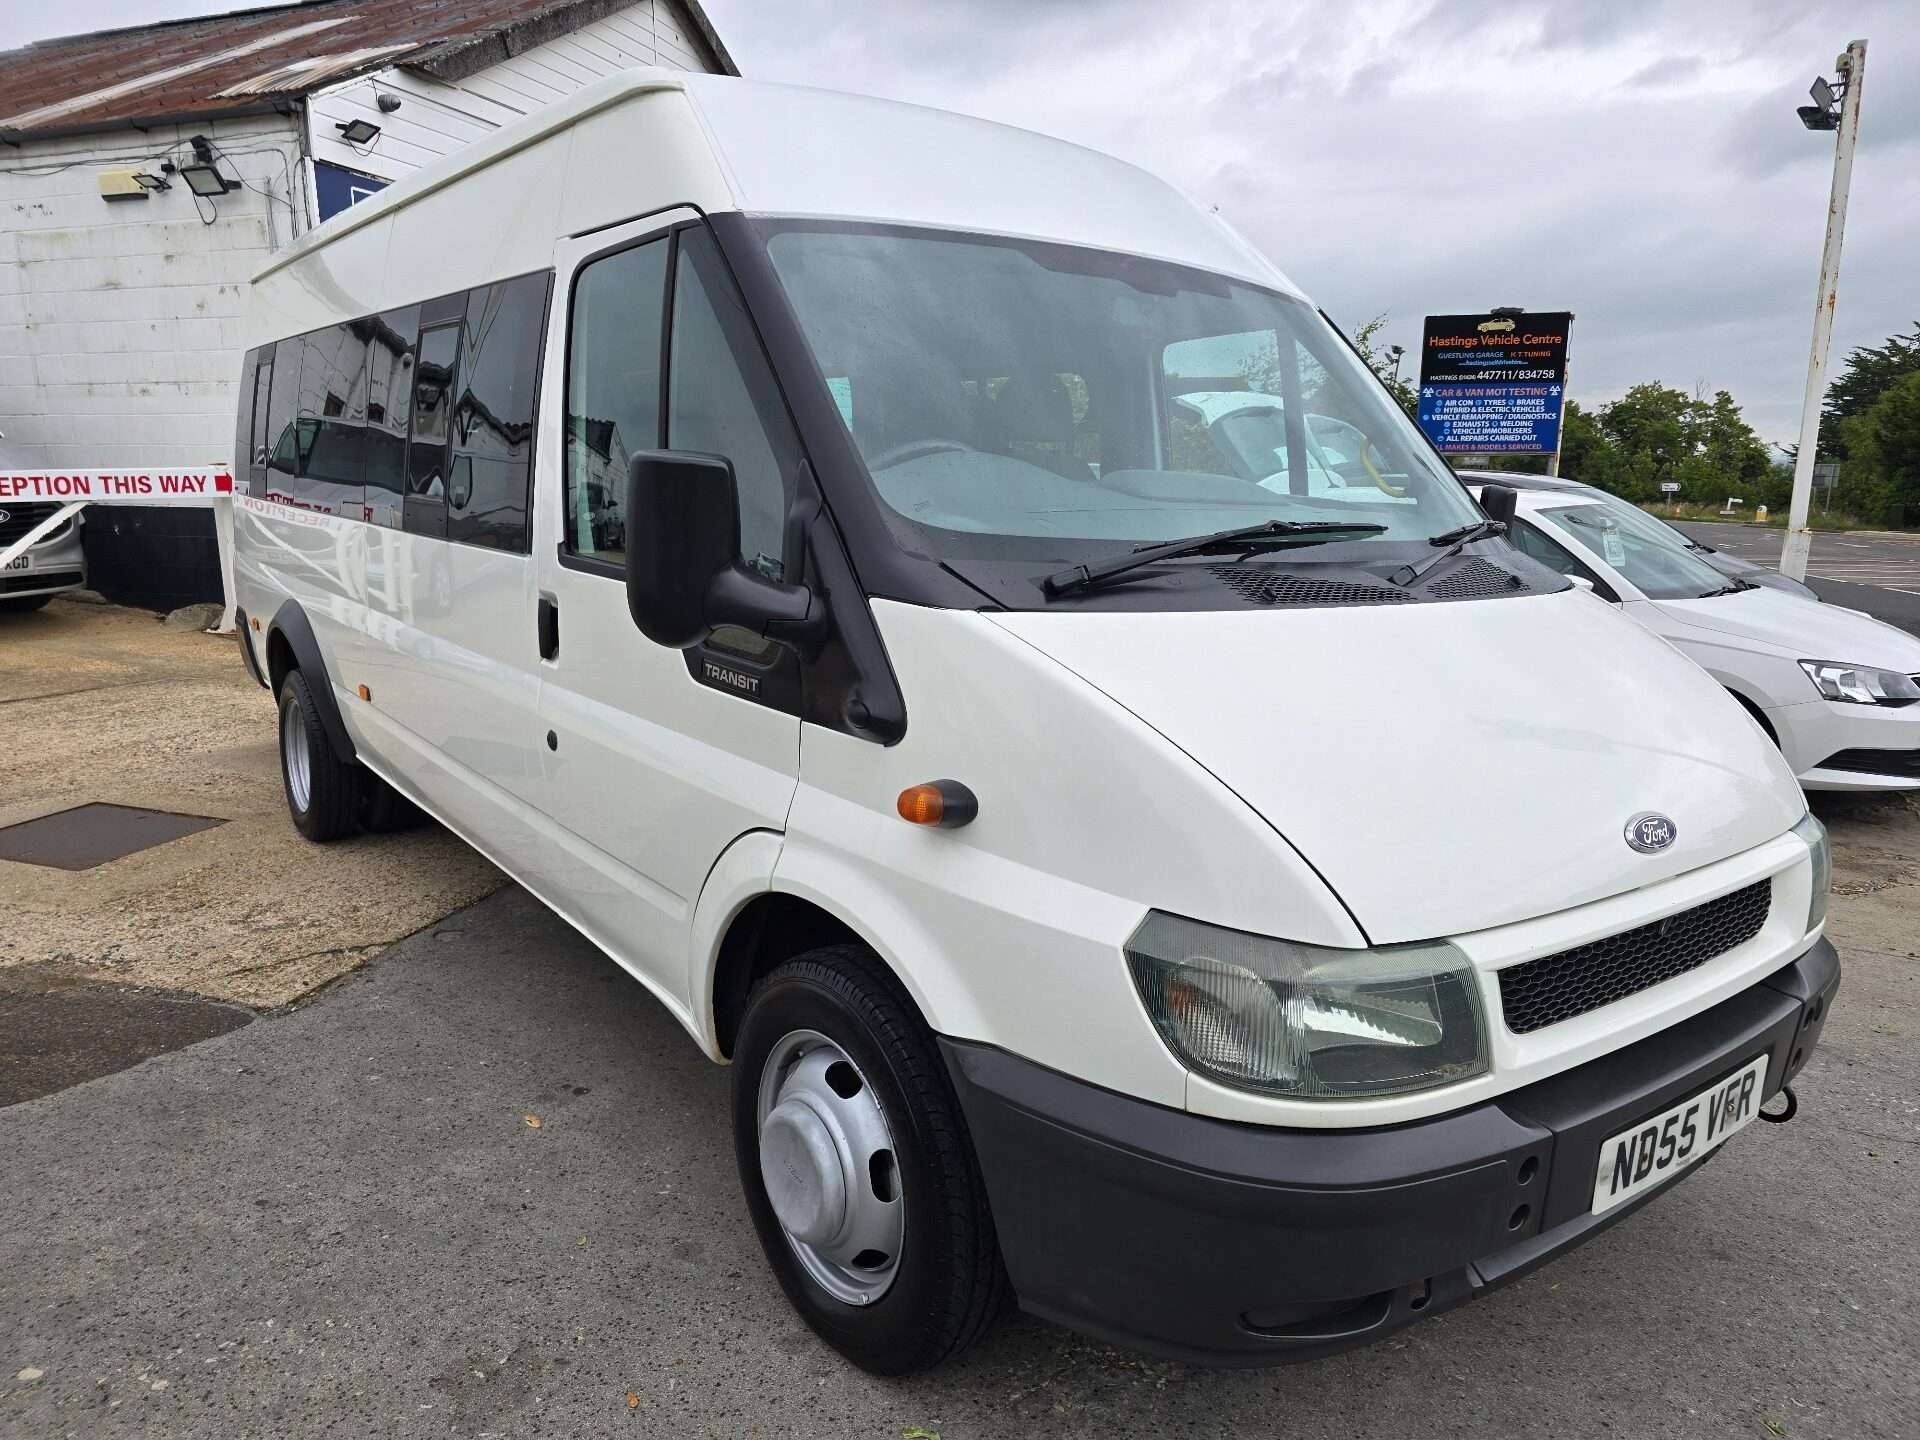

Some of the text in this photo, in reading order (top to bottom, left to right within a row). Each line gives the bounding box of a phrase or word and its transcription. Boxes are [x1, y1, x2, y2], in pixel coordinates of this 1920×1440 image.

[1429, 333, 1562, 348] Hastings Vehicle Centre
[1475, 351, 1504, 359] GARAGE
[1477, 369, 1555, 380] 447711/834758
[1435, 387, 1548, 398] CAR & VAN MOT TESTING
[1444, 399, 1457, 407] AIR
[1516, 398, 1545, 406] BRAKES
[1511, 405, 1545, 413] VEHICLES
[1508, 412, 1557, 420] DIAGNOSTICS
[1452, 420, 1490, 428] EXHAUSTS
[1460, 434, 1489, 442] REPAIRS
[98, 475, 151, 495] THIS
[159, 474, 207, 493] WAY
[705, 663, 759, 692] TRANSIT
[1642, 819, 1670, 844] Ford
[1610, 1104, 1700, 1196] ND55
